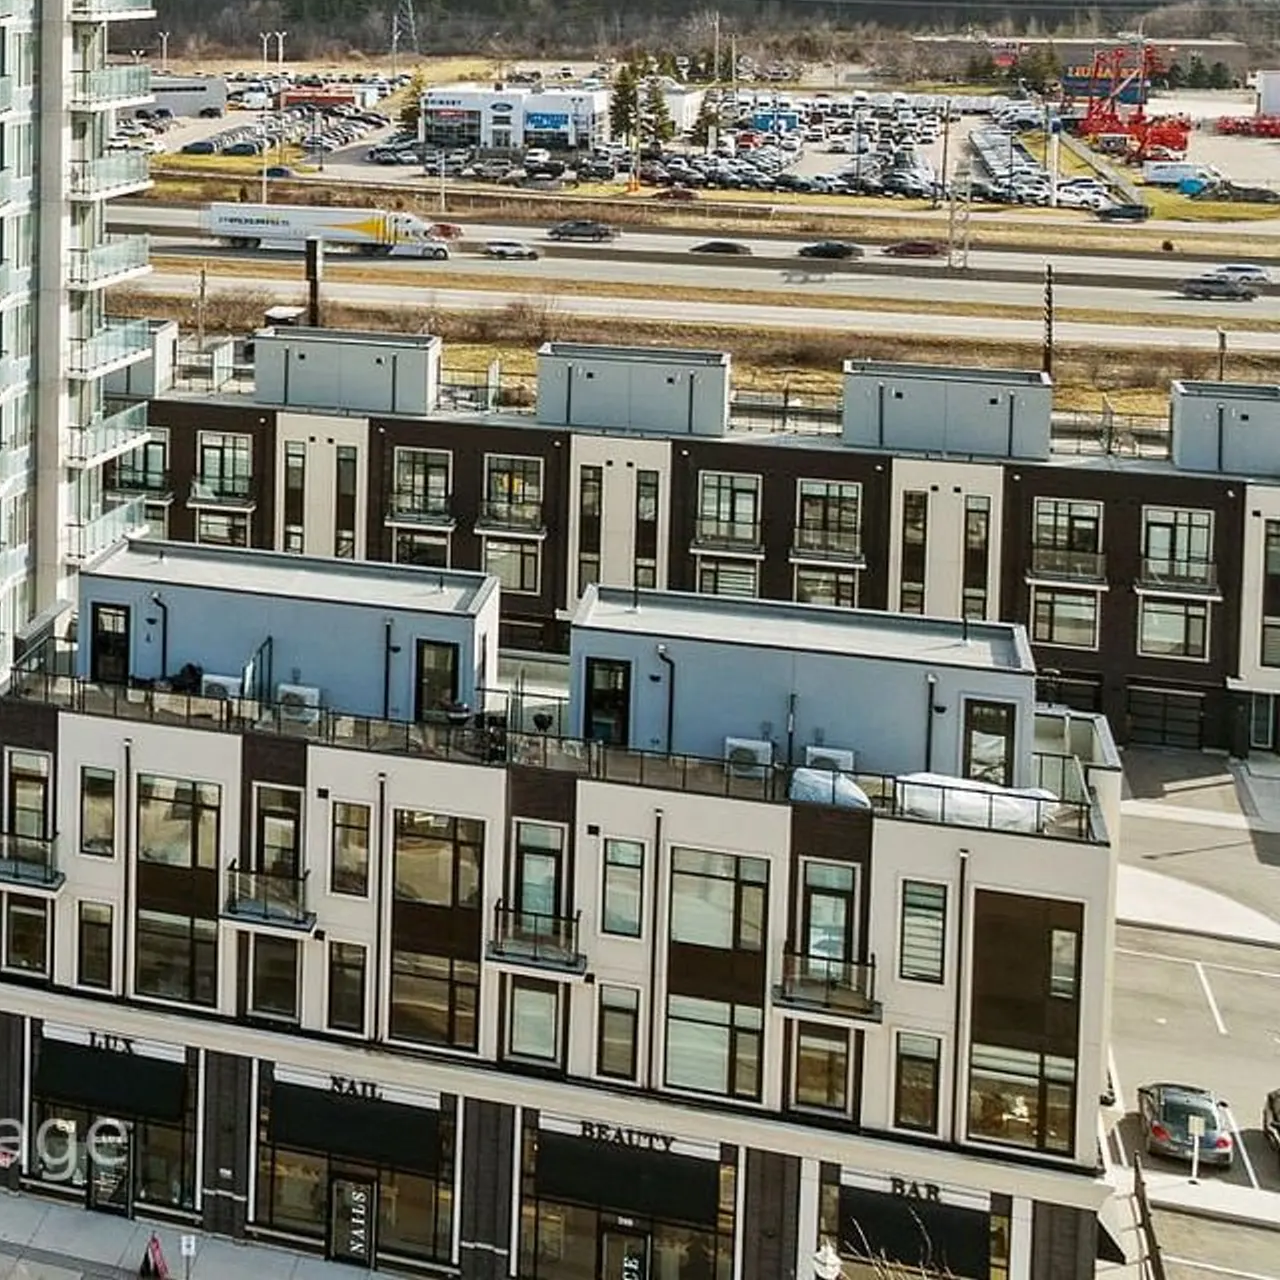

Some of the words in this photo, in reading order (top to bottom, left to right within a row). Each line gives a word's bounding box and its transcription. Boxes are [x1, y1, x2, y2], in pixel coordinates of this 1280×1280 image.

[330, 1075, 385, 1104] NAIL
[580, 1120, 676, 1154] BEAUTY
[890, 1177, 941, 1203] BAR
[350, 1191, 368, 1254] NAILS
